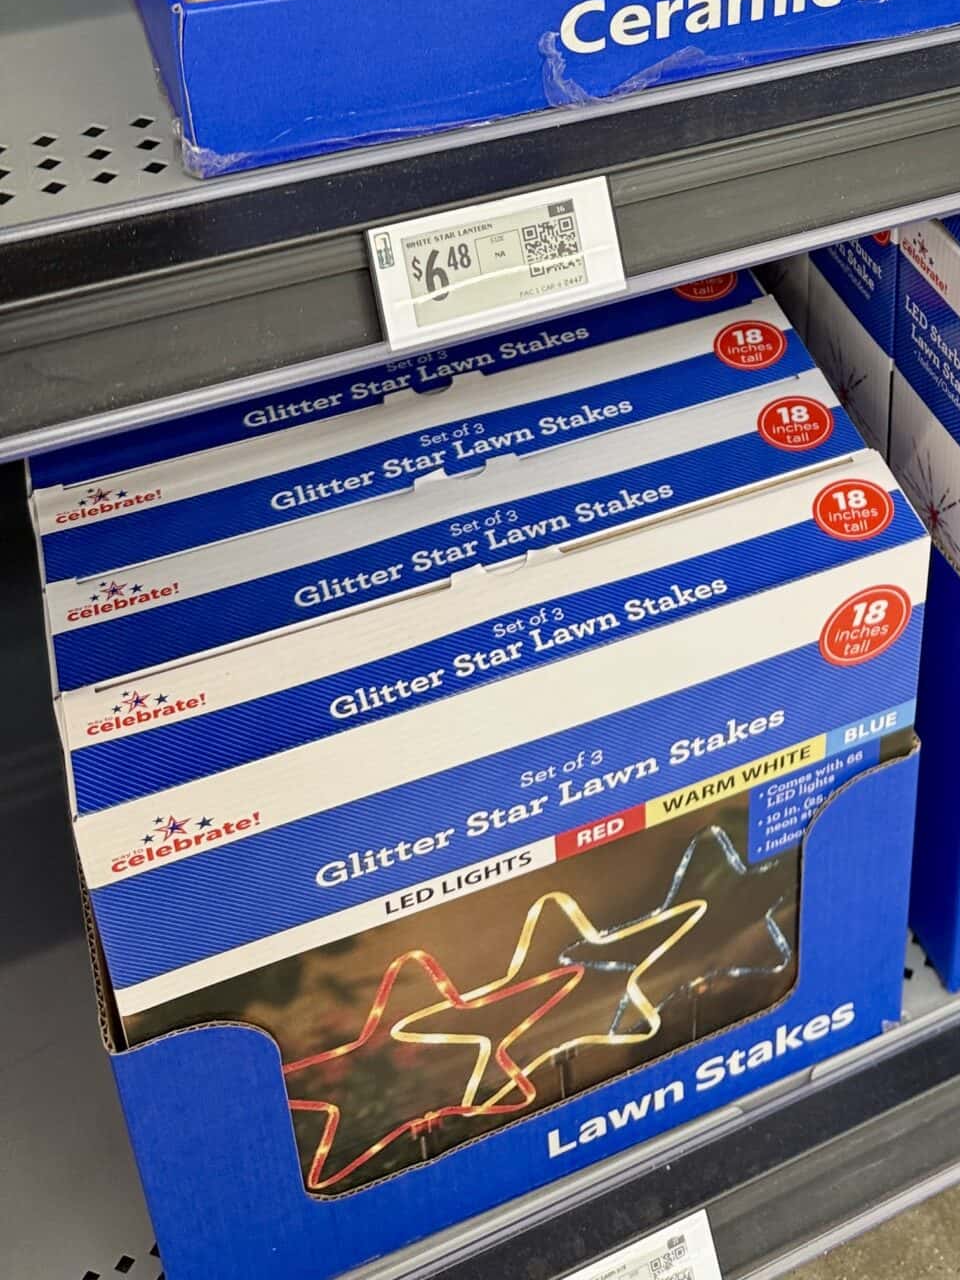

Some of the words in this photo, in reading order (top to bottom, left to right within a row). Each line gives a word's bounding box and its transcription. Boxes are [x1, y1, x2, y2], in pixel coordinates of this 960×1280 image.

[405, 235, 431, 250] WHITE
[433, 230, 455, 244] STAR
[457, 223, 493, 238] LANTERN
[902, 237, 948, 297] celebrate!
[905, 294, 928, 330] LED
[727, 341, 774, 357] inches
[731, 327, 765, 346] 18
[911, 322, 940, 370] Lawn
[416, 352, 434, 367] of
[438, 349, 448, 360] 3
[741, 350, 763, 364] tall
[243, 392, 342, 428] Glitter
[351, 374, 411, 401] Star
[416, 353, 494, 384] Lawn
[500, 325, 590, 361] Stakes
[772, 419, 821, 436] inches
[778, 405, 811, 425] 18
[420, 431, 450, 448] Set
[451, 424, 469, 441] of
[473, 422, 486, 435] 3
[785, 430, 810, 445] tall
[270, 470, 375, 511] Glitter
[383, 447, 446, 478] Star
[452, 428, 534, 460] Lawn
[538, 399, 634, 435] Stakes
[56, 488, 162, 524] celebrate!
[828, 506, 880, 524] inches
[832, 489, 869, 511] 18
[448, 520, 481, 538] Set
[484, 511, 503, 529] of
[505, 509, 519, 523] 3
[843, 519, 869, 534] tall
[293, 561, 404, 610] Glitter
[412, 540, 479, 573] Star
[486, 514, 571, 551] Lawn
[574, 483, 674, 523] Stakes
[67, 582, 180, 623] celebrate!
[852, 598, 889, 627] 18
[492, 620, 526, 640] Set
[529, 609, 549, 630] of
[551, 606, 565, 622] 3
[834, 621, 889, 644] inches
[329, 668, 445, 720] Glitter
[453, 641, 524, 679] Star
[530, 612, 620, 652] Lawn
[622, 577, 728, 622] Stakes
[844, 635, 871, 656] tall
[86, 693, 206, 737] celebrate!
[520, 768, 558, 789] Set
[562, 755, 587, 775] of
[589, 750, 604, 767] 3
[767, 773, 812, 796] Comes
[815, 758, 844, 777] with
[847, 750, 863, 765] 66
[315, 826, 455, 888] Glitter
[465, 795, 549, 838] Star
[558, 758, 660, 808] Lawn
[669, 708, 785, 765] Stakes
[767, 788, 796, 808] LED
[799, 774, 836, 796] lights
[385, 885, 435, 915] LED
[441, 851, 532, 896] LIGHTS
[576, 817, 625, 848] RED
[662, 776, 735, 814] WARM
[741, 744, 812, 783] WHITE
[843, 711, 897, 745] BLUE
[765, 816, 798, 837] neon
[111, 811, 261, 873] celebrate!
[547, 1080, 684, 1158] Lawn
[696, 1002, 856, 1091] Stakes
